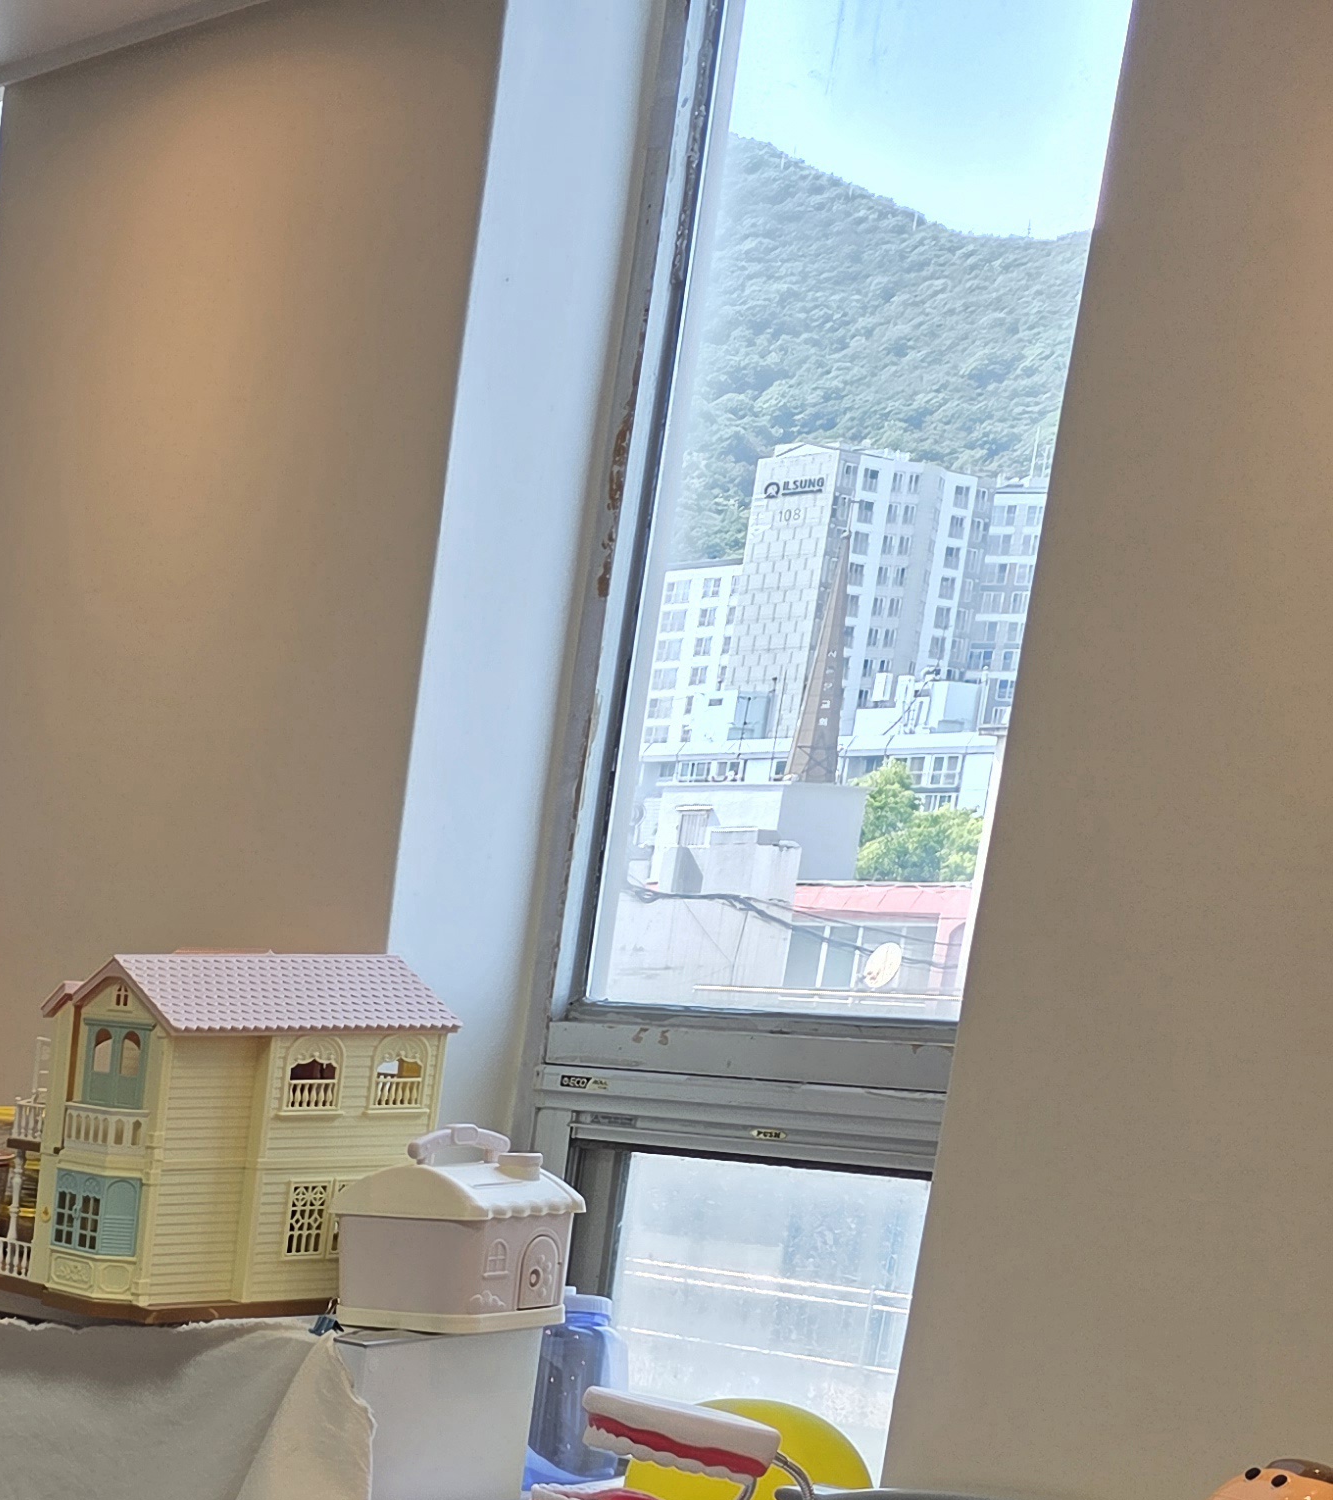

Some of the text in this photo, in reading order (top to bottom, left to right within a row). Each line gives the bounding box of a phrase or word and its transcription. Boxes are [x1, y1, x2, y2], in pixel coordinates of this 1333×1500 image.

[782, 476, 825, 491] ILSUNG
[779, 507, 801, 522] 108
[569, 1077, 588, 1088] ECO
[756, 1130, 781, 1139] PUSH
